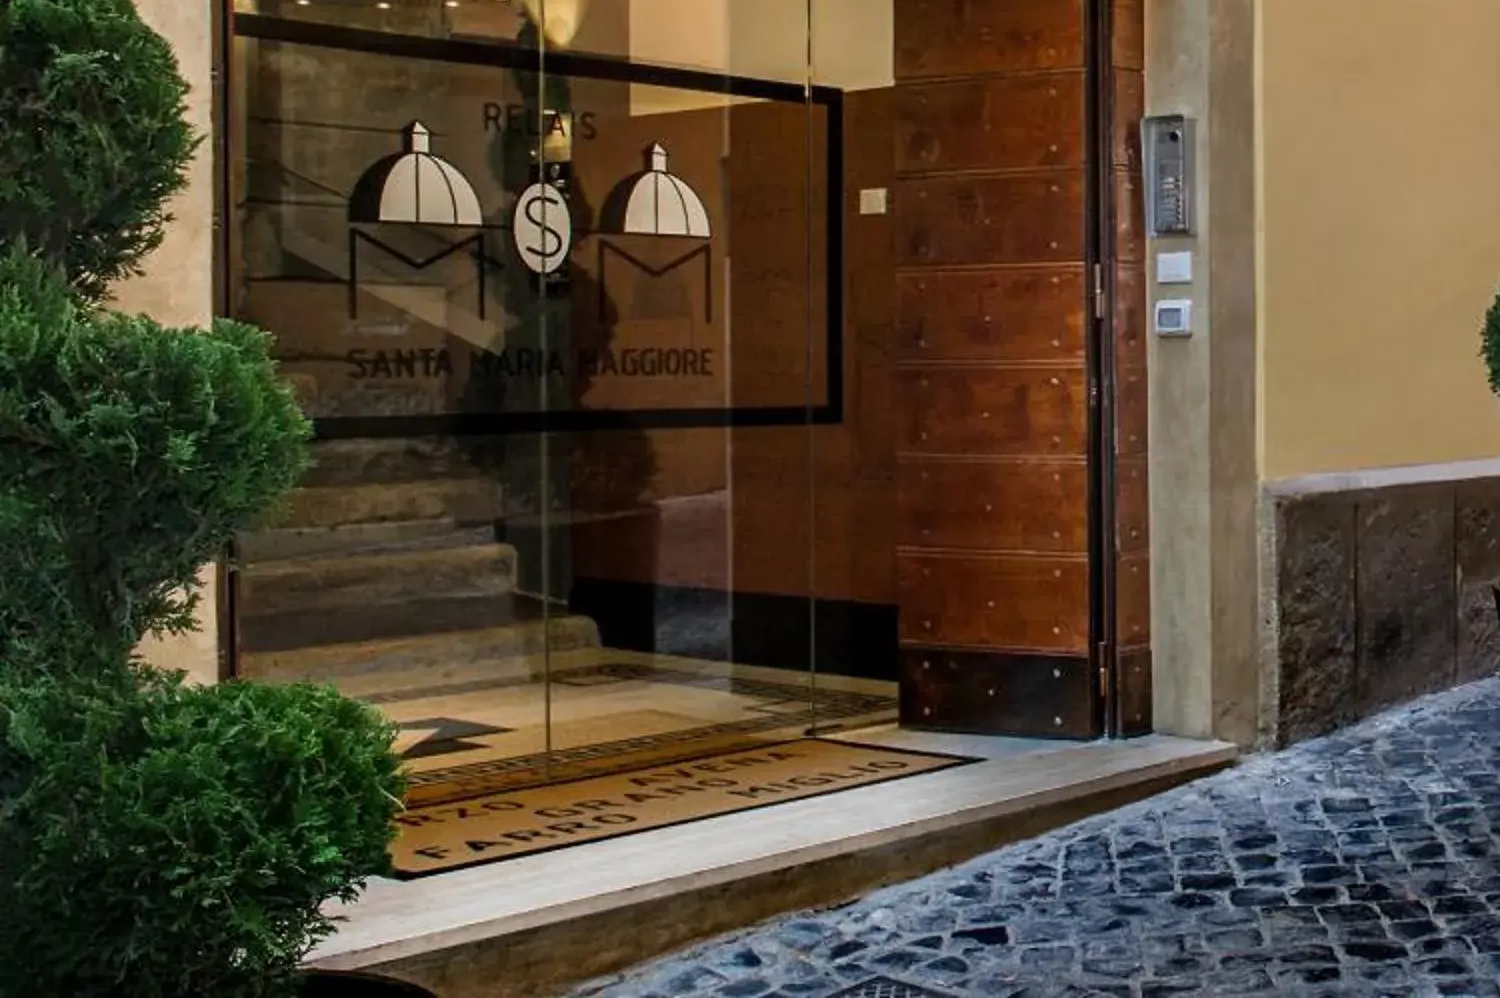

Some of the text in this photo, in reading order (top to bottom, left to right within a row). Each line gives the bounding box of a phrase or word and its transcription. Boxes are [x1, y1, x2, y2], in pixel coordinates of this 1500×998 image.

[482, 102, 598, 140] RELAIS
[347, 347, 714, 380] SANTA MARIA MAGGIORE
[396, 799, 526, 828] RZO
[413, 760, 909, 860] FARRO MIGLIO
